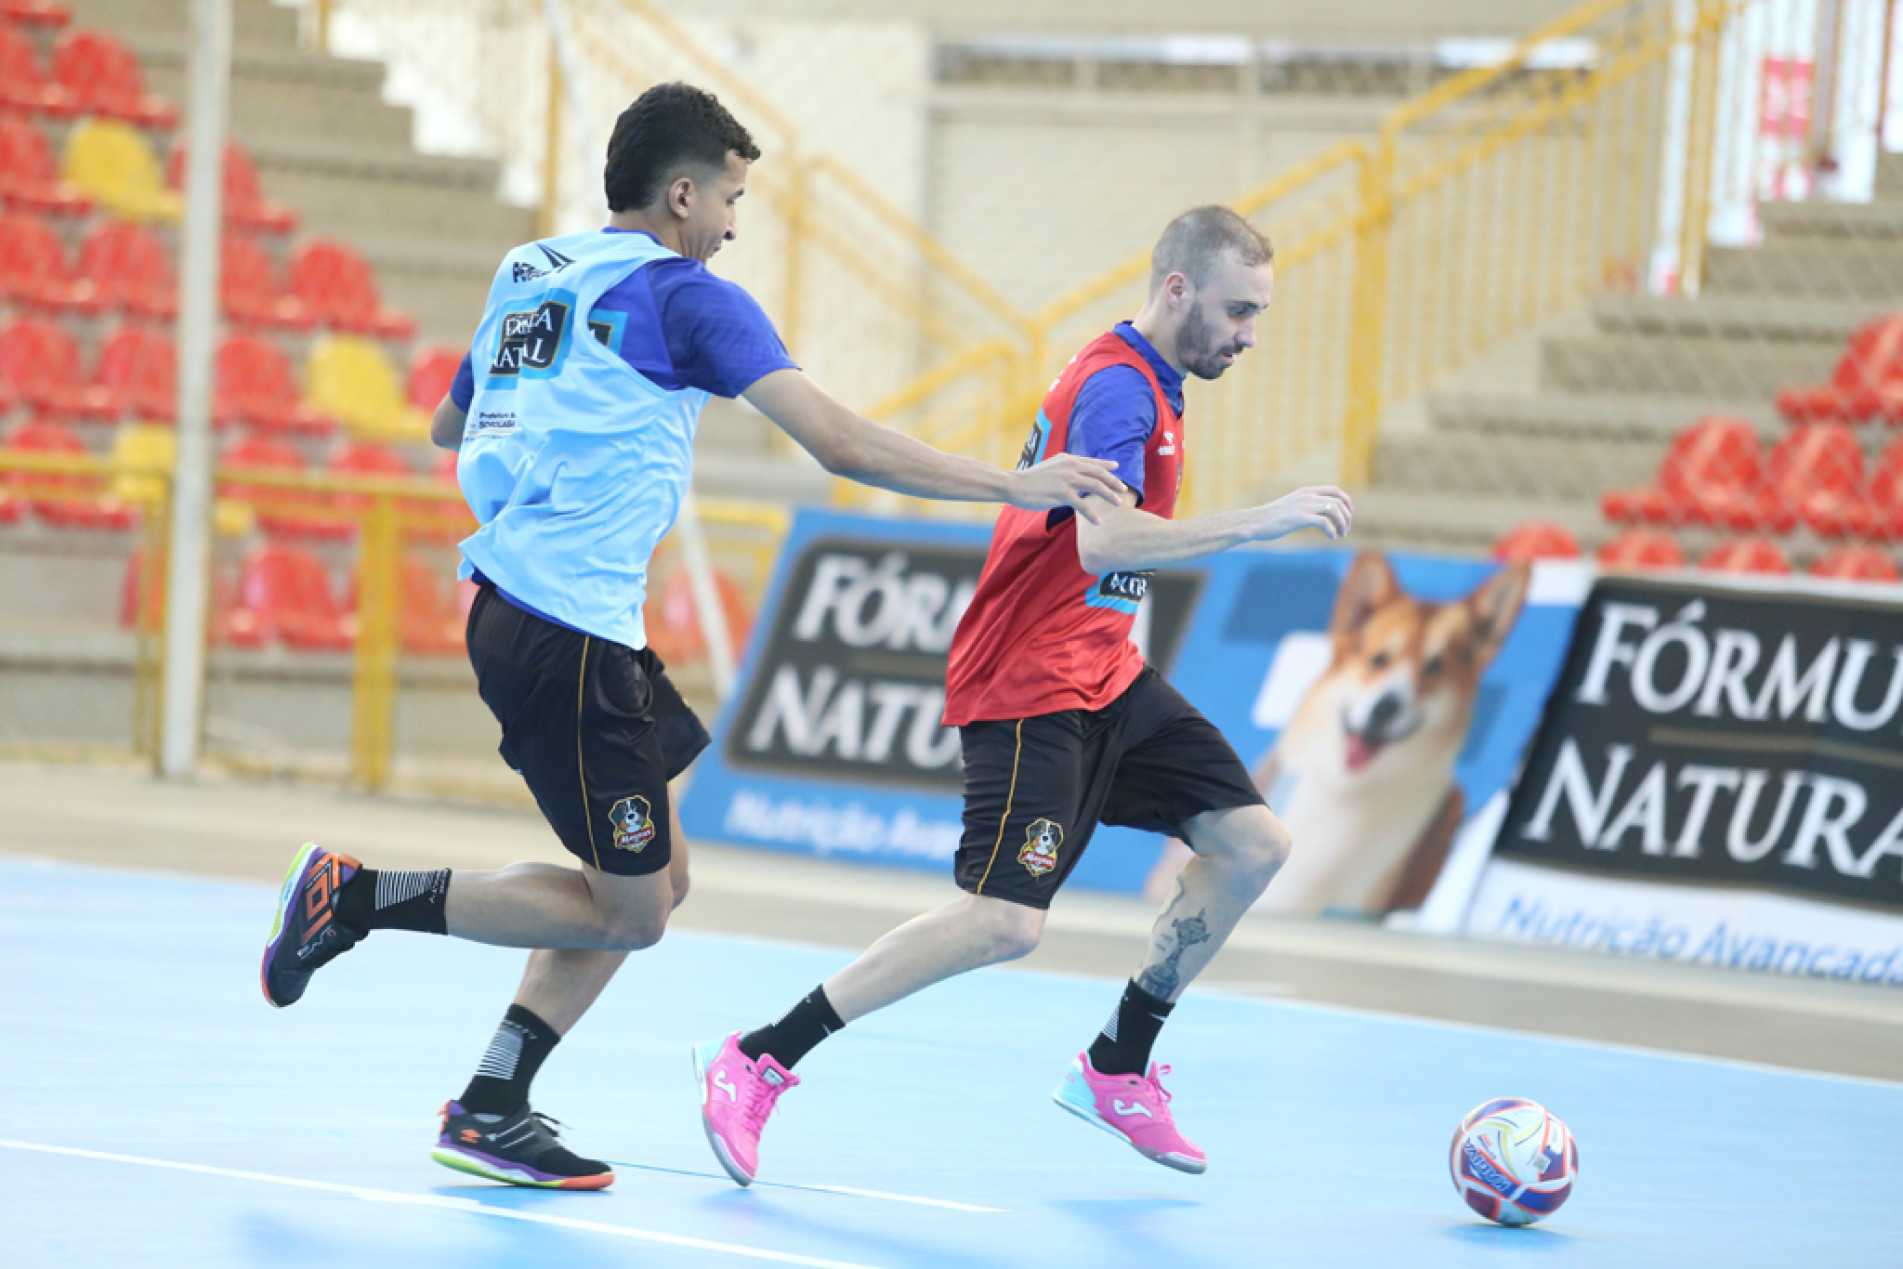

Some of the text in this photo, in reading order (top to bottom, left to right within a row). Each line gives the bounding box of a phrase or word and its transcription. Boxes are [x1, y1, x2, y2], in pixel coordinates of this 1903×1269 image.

[796, 551, 977, 652] FÓR
[747, 662, 966, 772] NATU
[1573, 598, 1903, 730] FÓRMU
